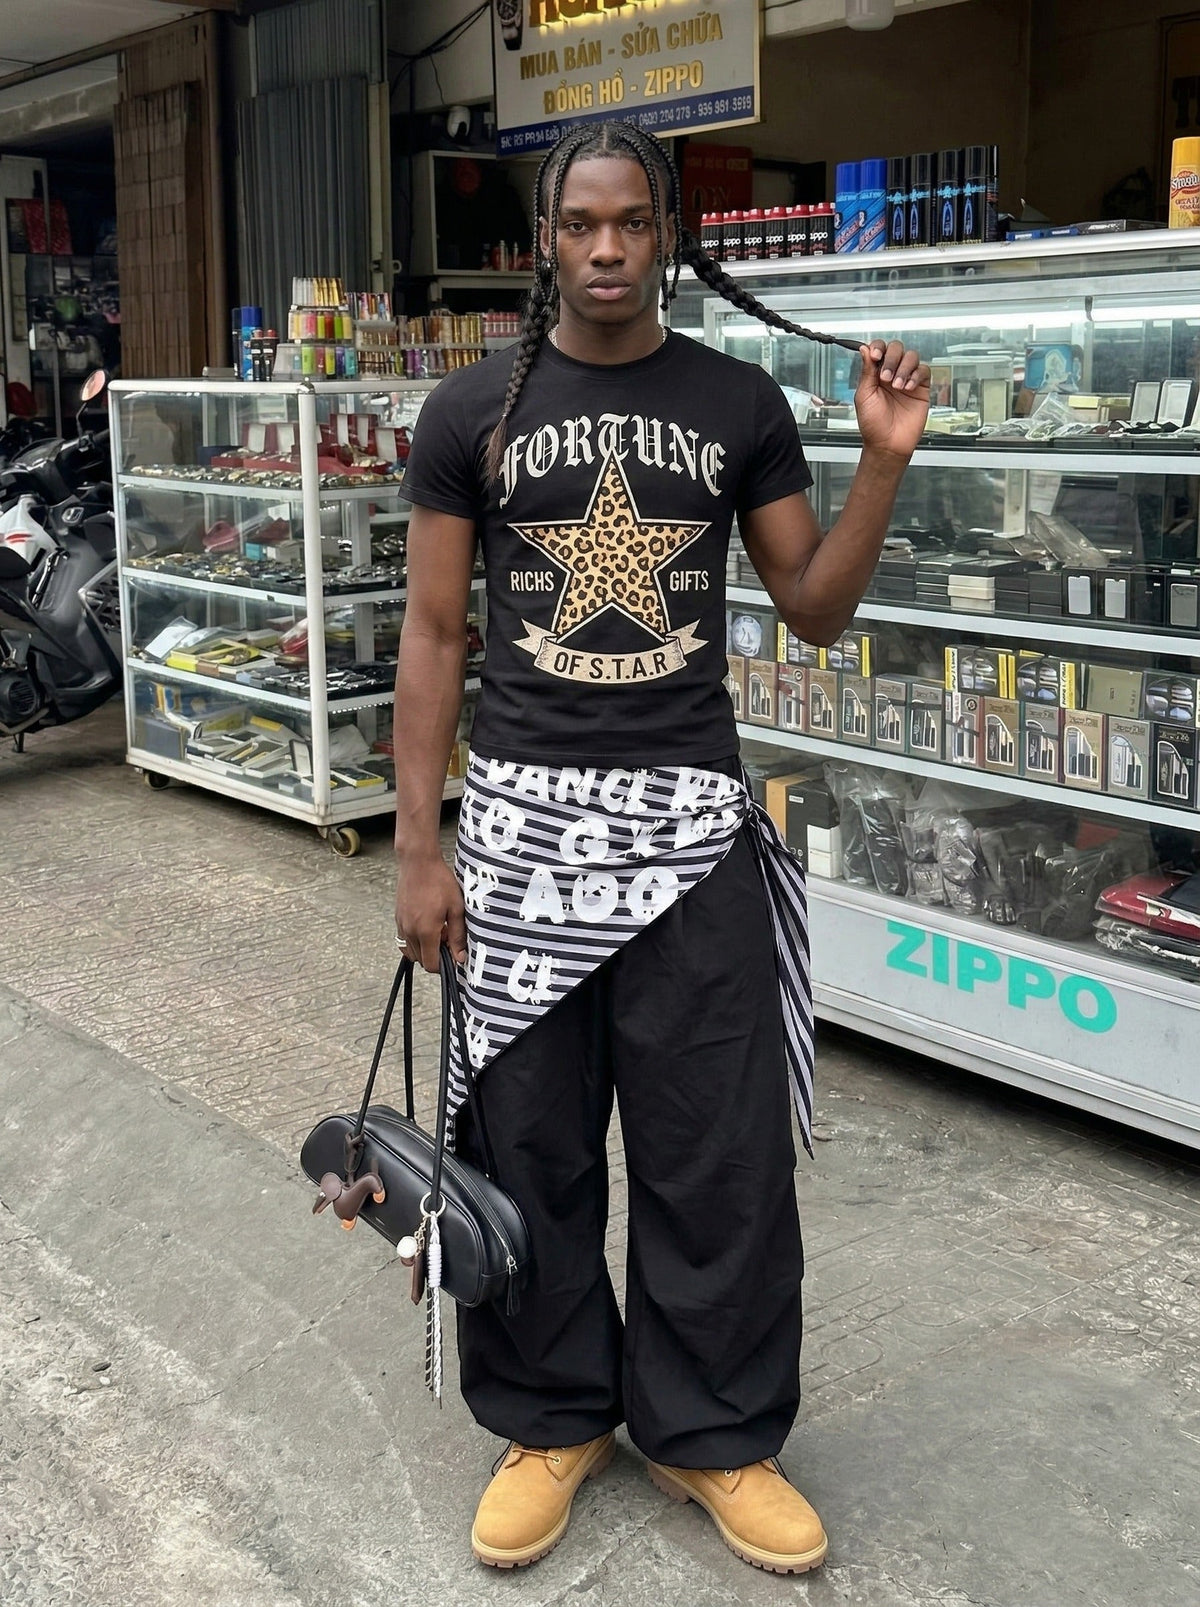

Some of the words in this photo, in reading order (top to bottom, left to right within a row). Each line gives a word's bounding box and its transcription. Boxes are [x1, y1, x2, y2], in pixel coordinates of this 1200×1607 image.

[520, 52, 559, 81] MUA
[564, 38, 602, 73] BÁN
[621, 21, 660, 59] SỬA
[665, 11, 723, 49] CHỮA
[544, 80, 593, 115] ĐỒNG
[599, 67, 624, 105] HỒ
[644, 60, 704, 97] ZIPPO
[500, 412, 727, 509] FORTUNE
[510, 570, 555, 592] RICHS
[669, 570, 709, 592] GIFTS
[553, 652, 584, 676] OF
[588, 652, 669, 681] S.T.A.R
[886, 919, 1117, 1034] ZIPPO
